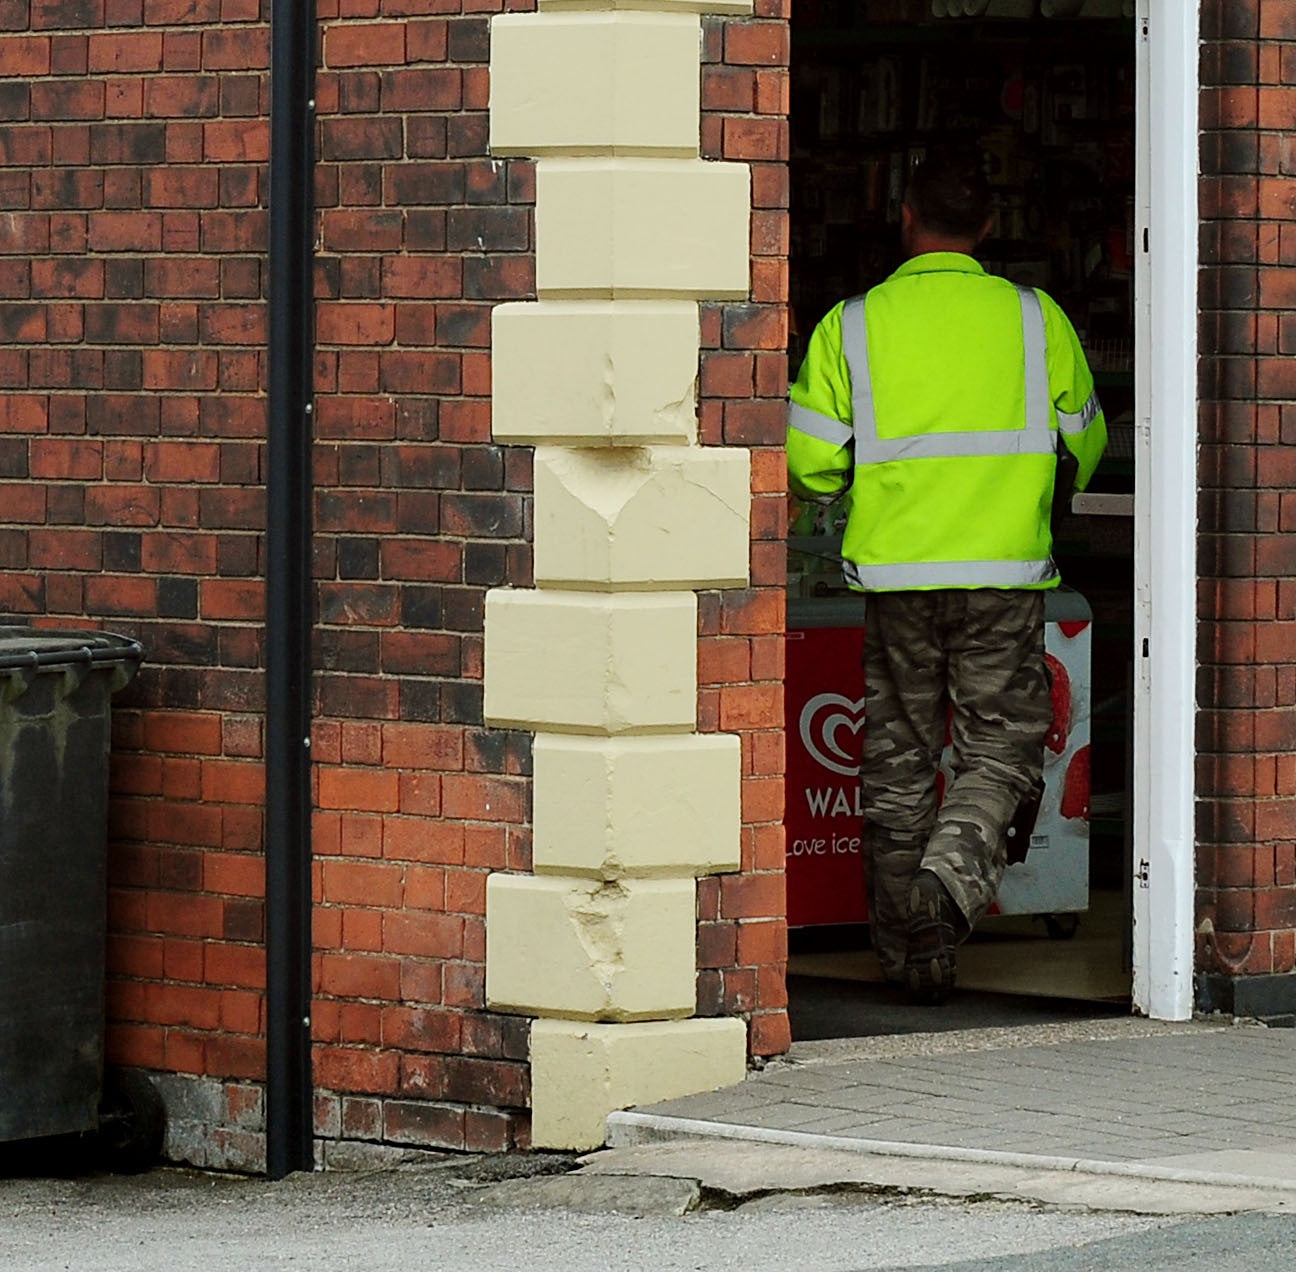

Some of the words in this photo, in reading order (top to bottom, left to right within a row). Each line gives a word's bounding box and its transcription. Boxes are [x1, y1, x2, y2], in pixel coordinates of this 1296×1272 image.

[805, 786, 864, 819] WAL
[786, 838, 826, 856] ove
[832, 832, 861, 854] ice
